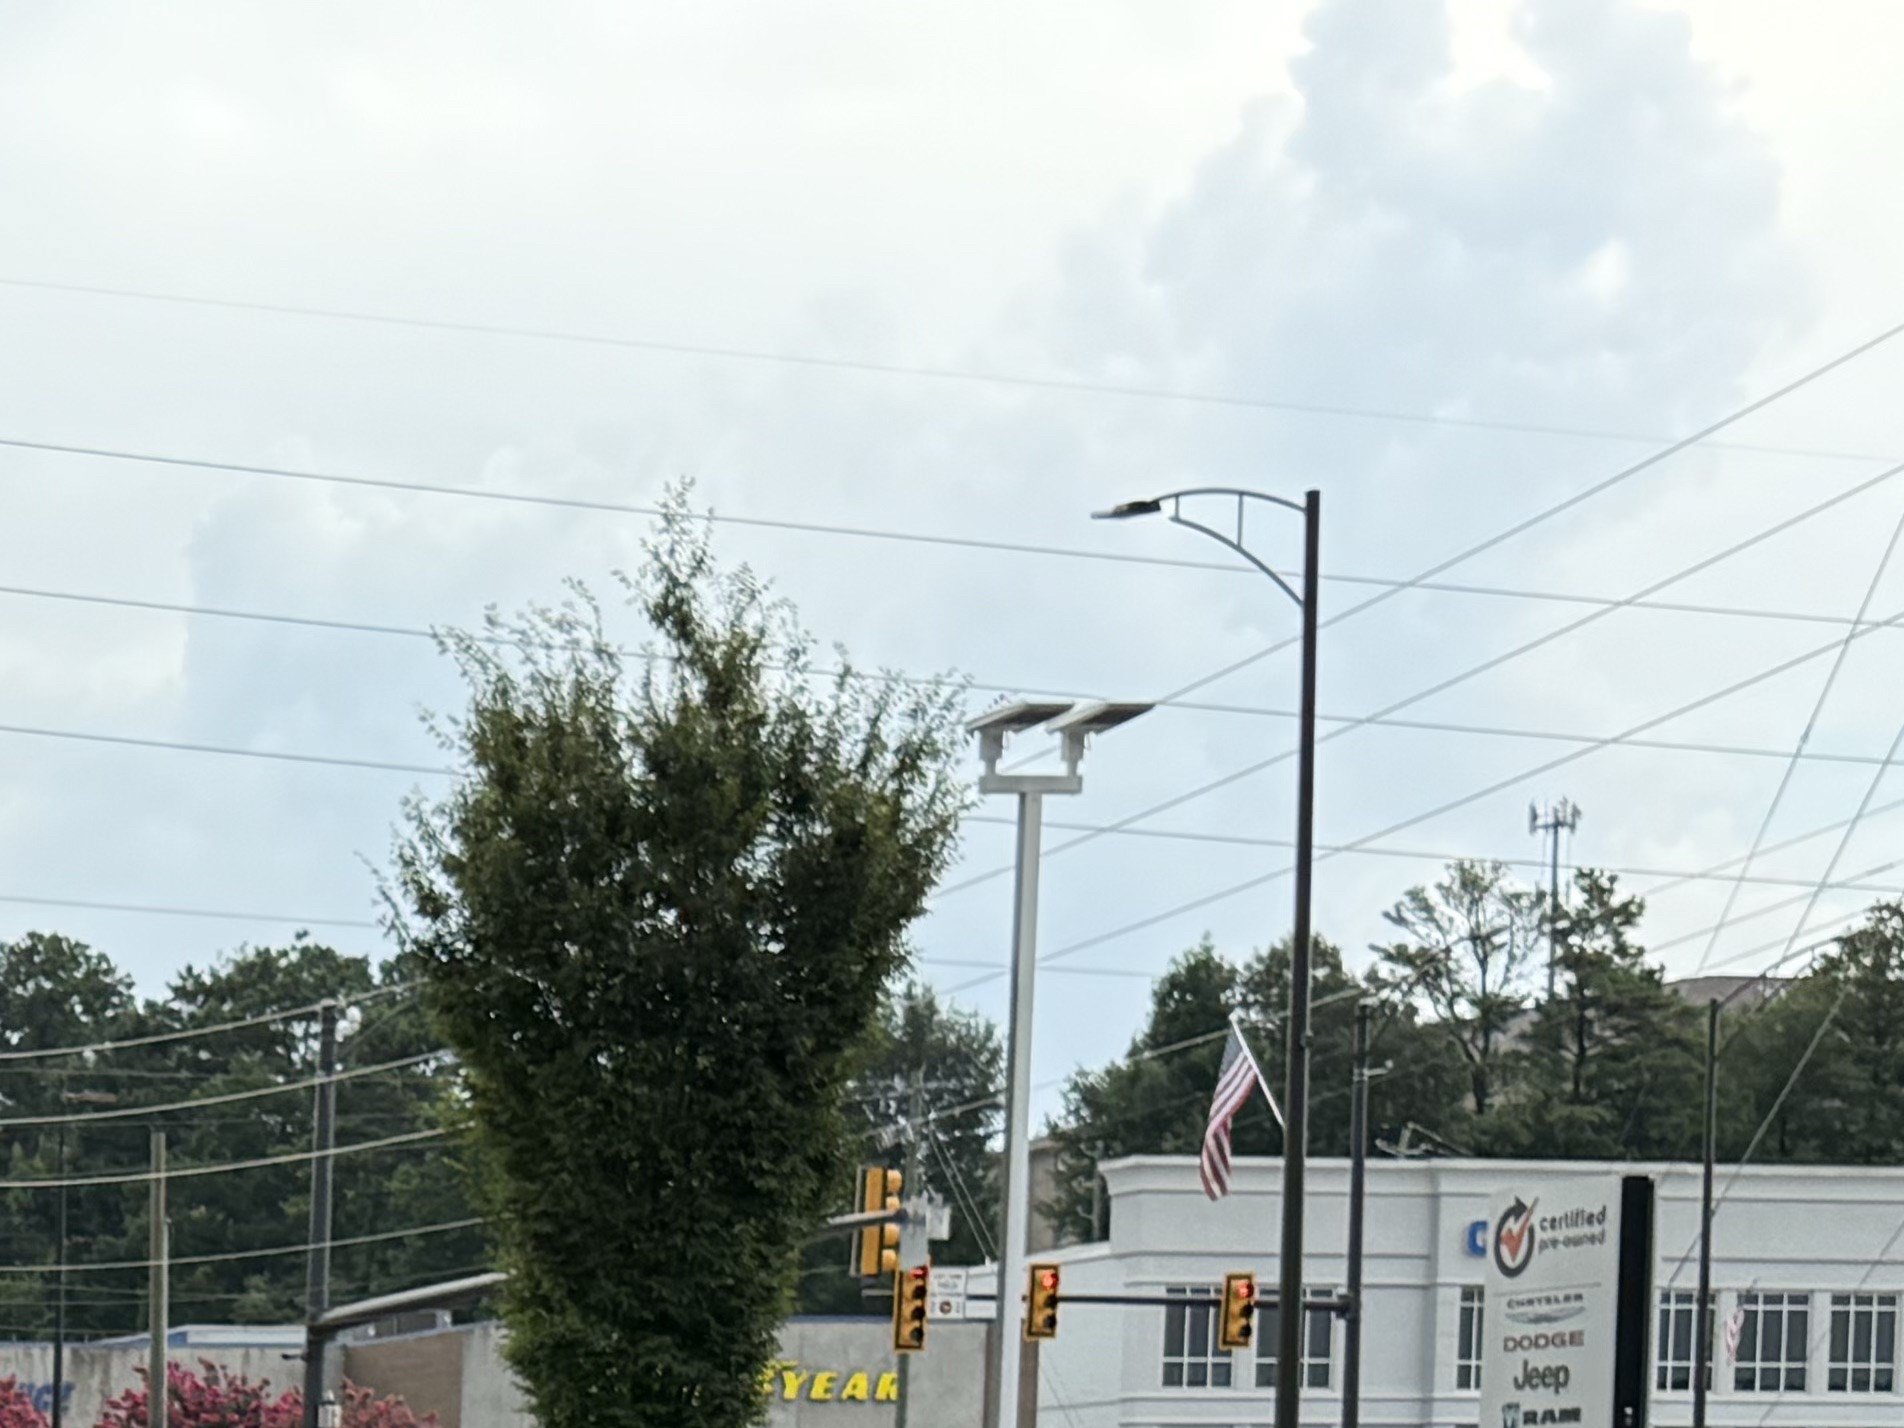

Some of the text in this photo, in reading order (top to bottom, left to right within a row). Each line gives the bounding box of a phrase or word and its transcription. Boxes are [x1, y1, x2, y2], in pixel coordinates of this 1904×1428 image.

[1539, 1206, 1606, 1231] certified
[1539, 1229, 1606, 1254] pre-owned
[1506, 1293, 1584, 1309] CHRYSLER
[1503, 1329, 1585, 1352] DODGE
[1513, 1360, 1569, 1396] Jeep
[1523, 1407, 1582, 1425] RAM
